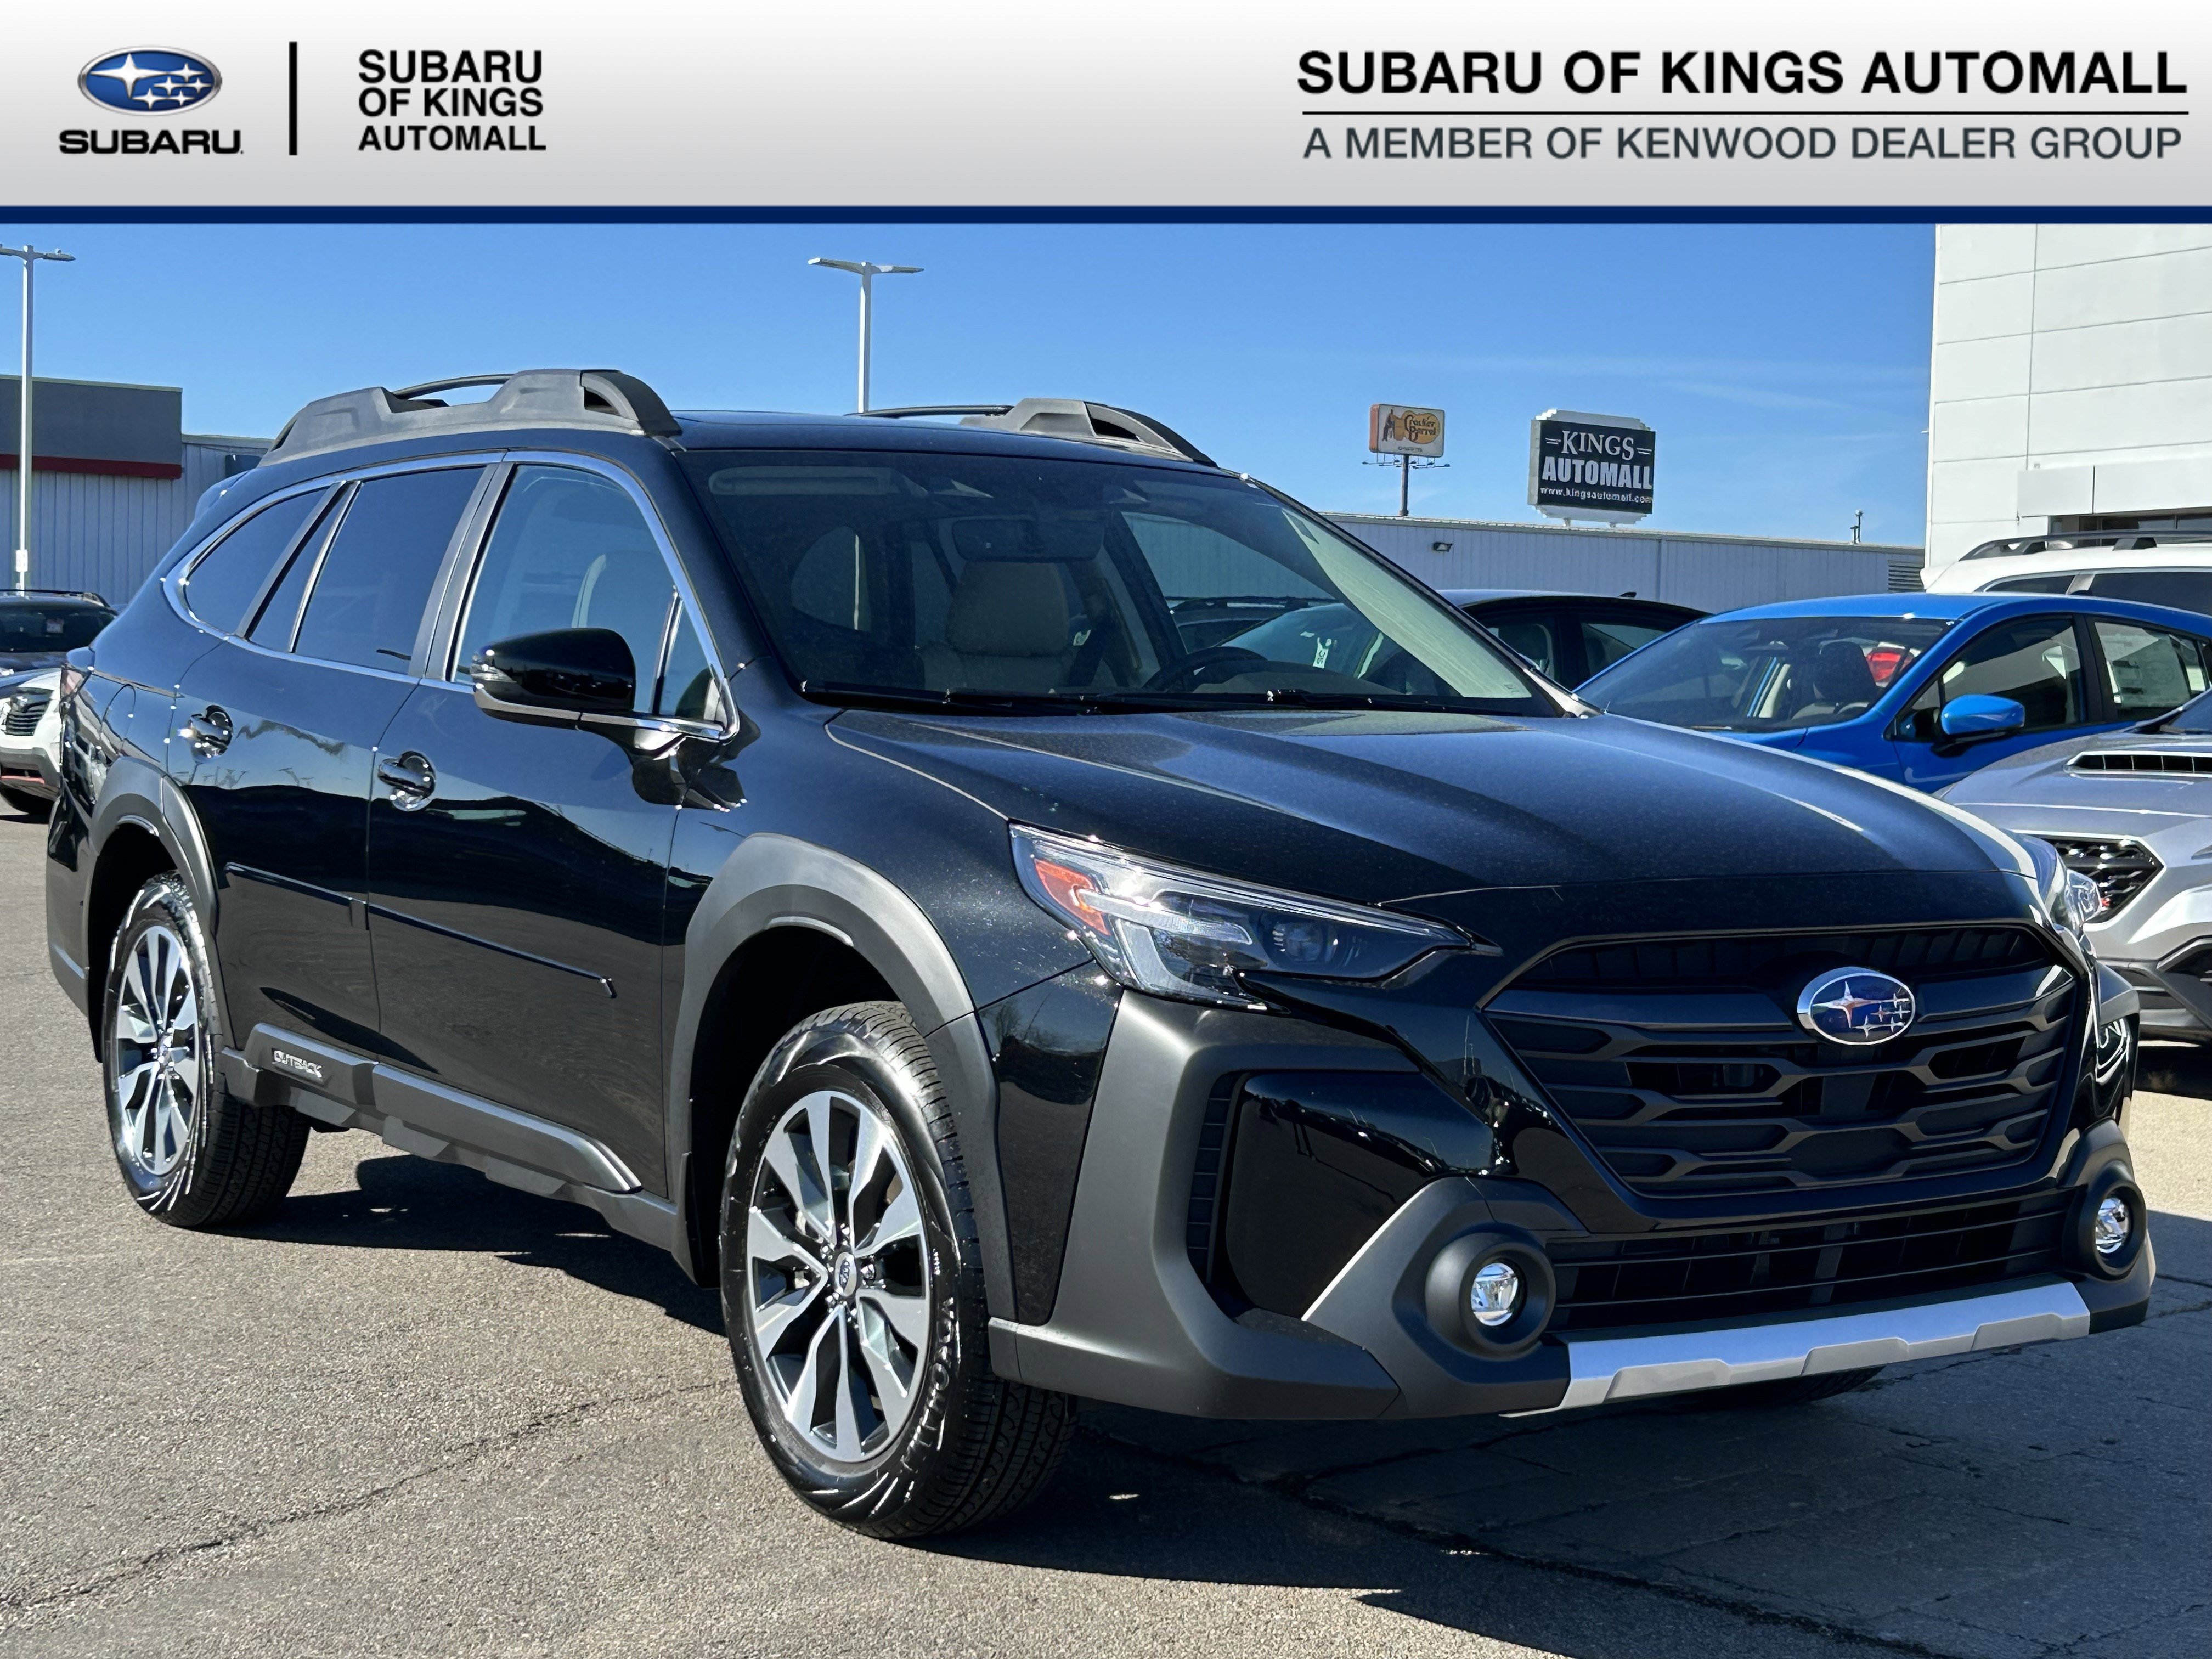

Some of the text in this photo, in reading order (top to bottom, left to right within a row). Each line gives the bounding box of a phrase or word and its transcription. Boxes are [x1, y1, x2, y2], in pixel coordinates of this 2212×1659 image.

[1561, 430, 1634, 461] KINGS
[1542, 456, 1652, 489] AUTOMALL
[274, 1050, 323, 1078] OUTBACK
